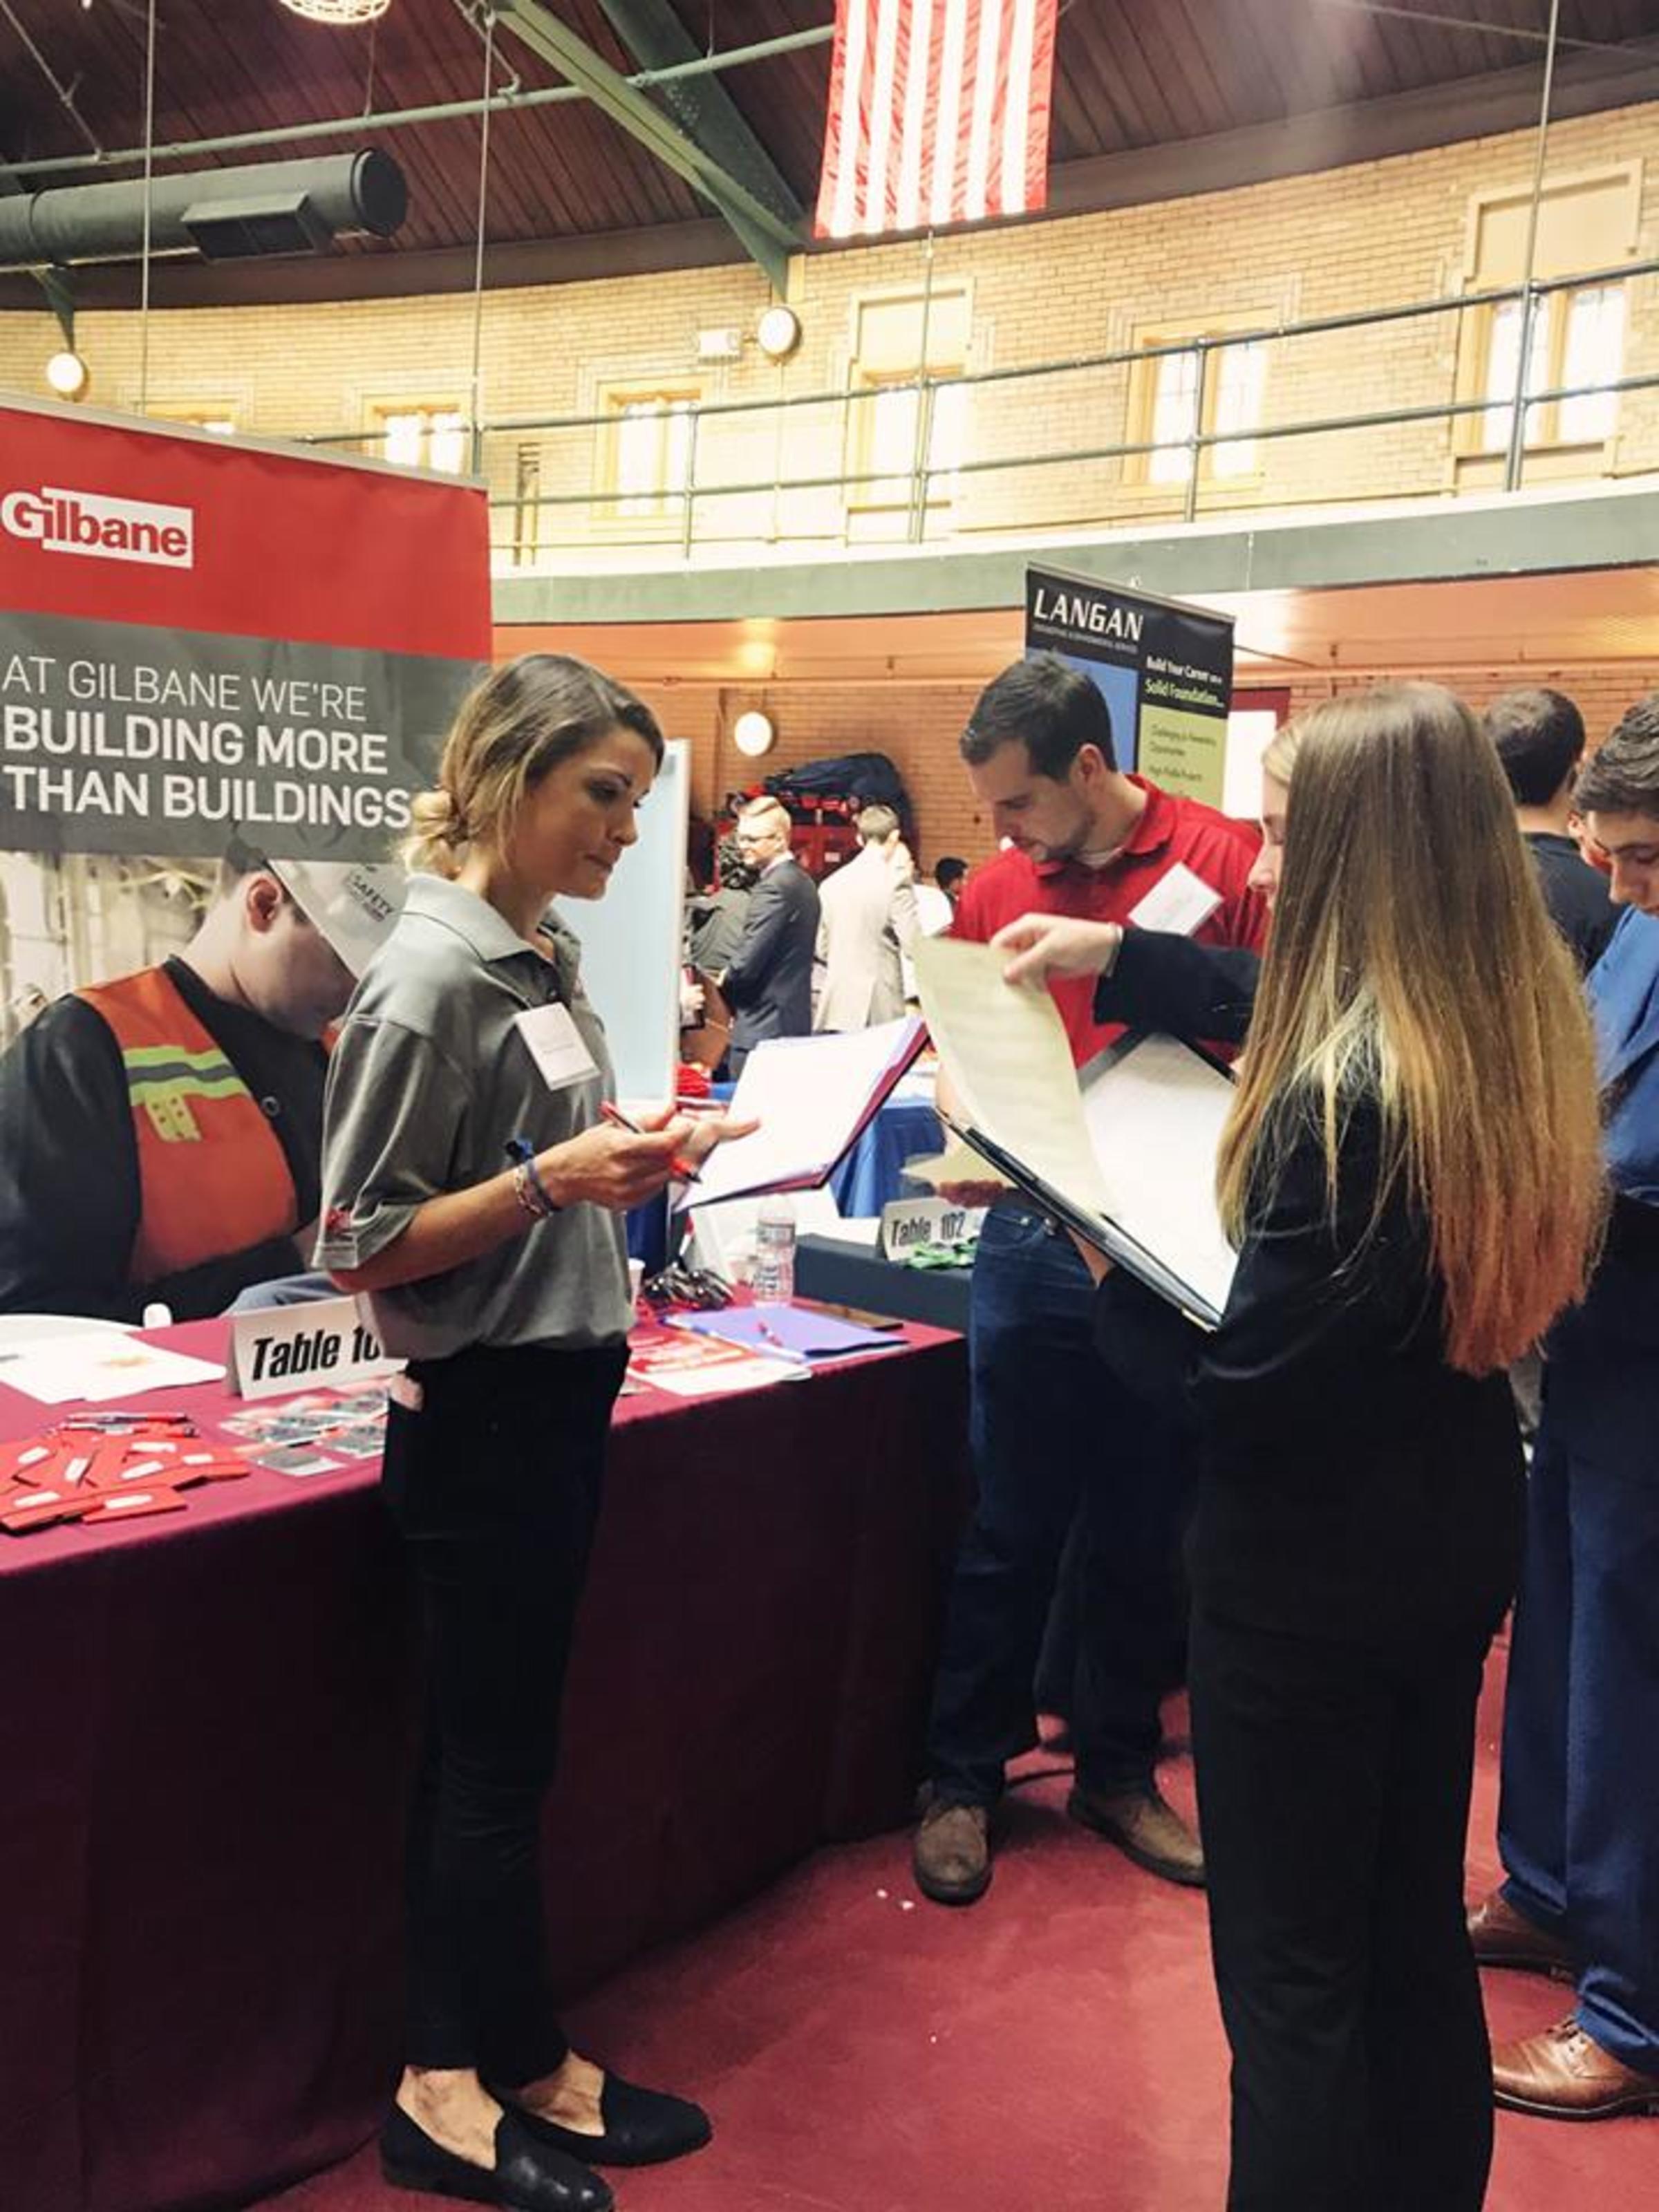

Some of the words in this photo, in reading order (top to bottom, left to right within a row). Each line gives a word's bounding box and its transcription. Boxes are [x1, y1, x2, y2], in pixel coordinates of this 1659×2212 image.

[1, 491, 188, 557] Gilbane
[1034, 589, 1143, 641] LANGAN
[2, 655, 56, 694] AT
[68, 660, 241, 711] GILBANE
[251, 677, 366, 722] WE'RE
[4, 704, 244, 765] BUILDING
[257, 725, 388, 774] MORE
[3, 765, 148, 816] THAN
[164, 774, 411, 828] BUILDINGS
[892, 1216, 931, 1246] Table
[941, 1211, 965, 1240] 102
[253, 1329, 341, 1380] Table
